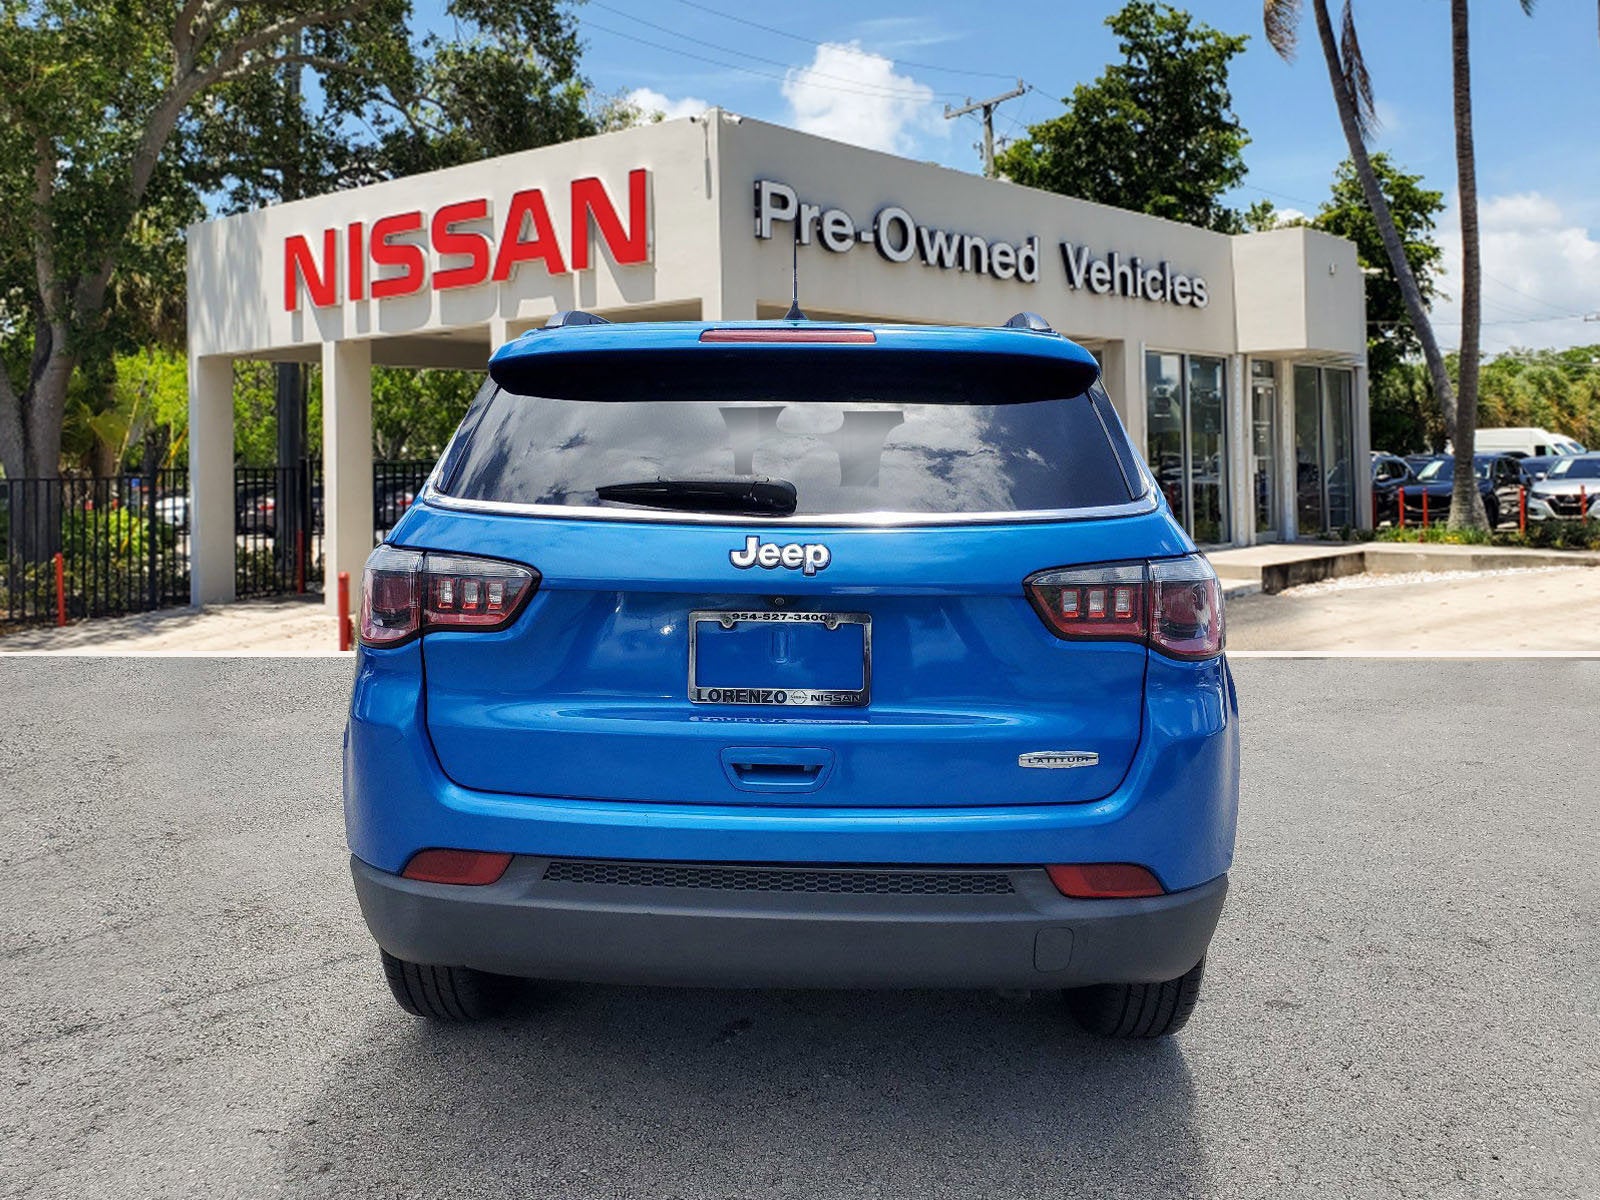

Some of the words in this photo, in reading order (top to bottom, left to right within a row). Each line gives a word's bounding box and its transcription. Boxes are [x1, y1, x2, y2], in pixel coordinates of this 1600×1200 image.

[285, 168, 647, 312] NISSAN
[755, 180, 1039, 283] Pre-Owned
[1060, 242, 1209, 308] Vehicles
[729, 536, 831, 576] Jeep
[732, 612, 828, 622] 954-527-3400
[697, 689, 788, 704] LORENZO
[810, 693, 861, 703] NISSAN
